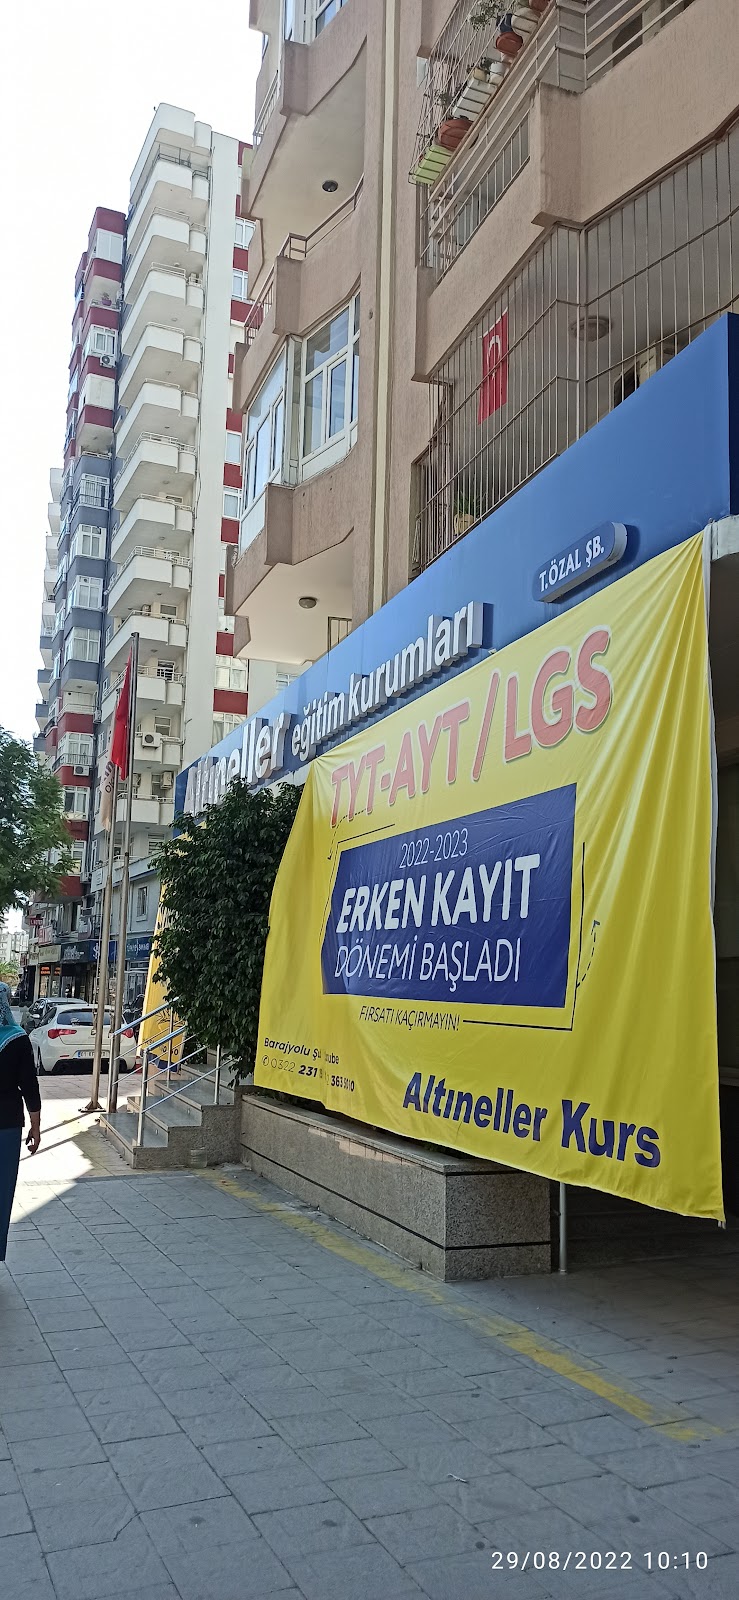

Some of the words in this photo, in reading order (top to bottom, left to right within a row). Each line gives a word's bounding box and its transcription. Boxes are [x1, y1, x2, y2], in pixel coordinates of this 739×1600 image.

[539, 548, 582, 592] T.ÖZAL
[585, 535, 605, 568] ŞB.
[291, 690, 346, 762] eğitim
[348, 601, 484, 722] kurumları
[330, 701, 470, 828] TYT-AYT
[504, 625, 614, 764] LGS
[399, 828, 469, 869] 2022-2023
[335, 874, 427, 934] ERKEN
[430, 853, 541, 925] KAYIT
[334, 935, 419, 980] DÖNEMİ
[420, 937, 522, 993] BAŞLADI
[263, 1037, 311, 1057] Barajyolu
[359, 1005, 395, 1025] FIRSATI
[395, 1009, 461, 1032] KAÇIRMAYIN!
[270, 1058, 296, 1073] 0322
[298, 1064, 319, 1078] 231
[402, 1071, 548, 1143] Altıneller
[560, 1098, 662, 1170] Kurs
